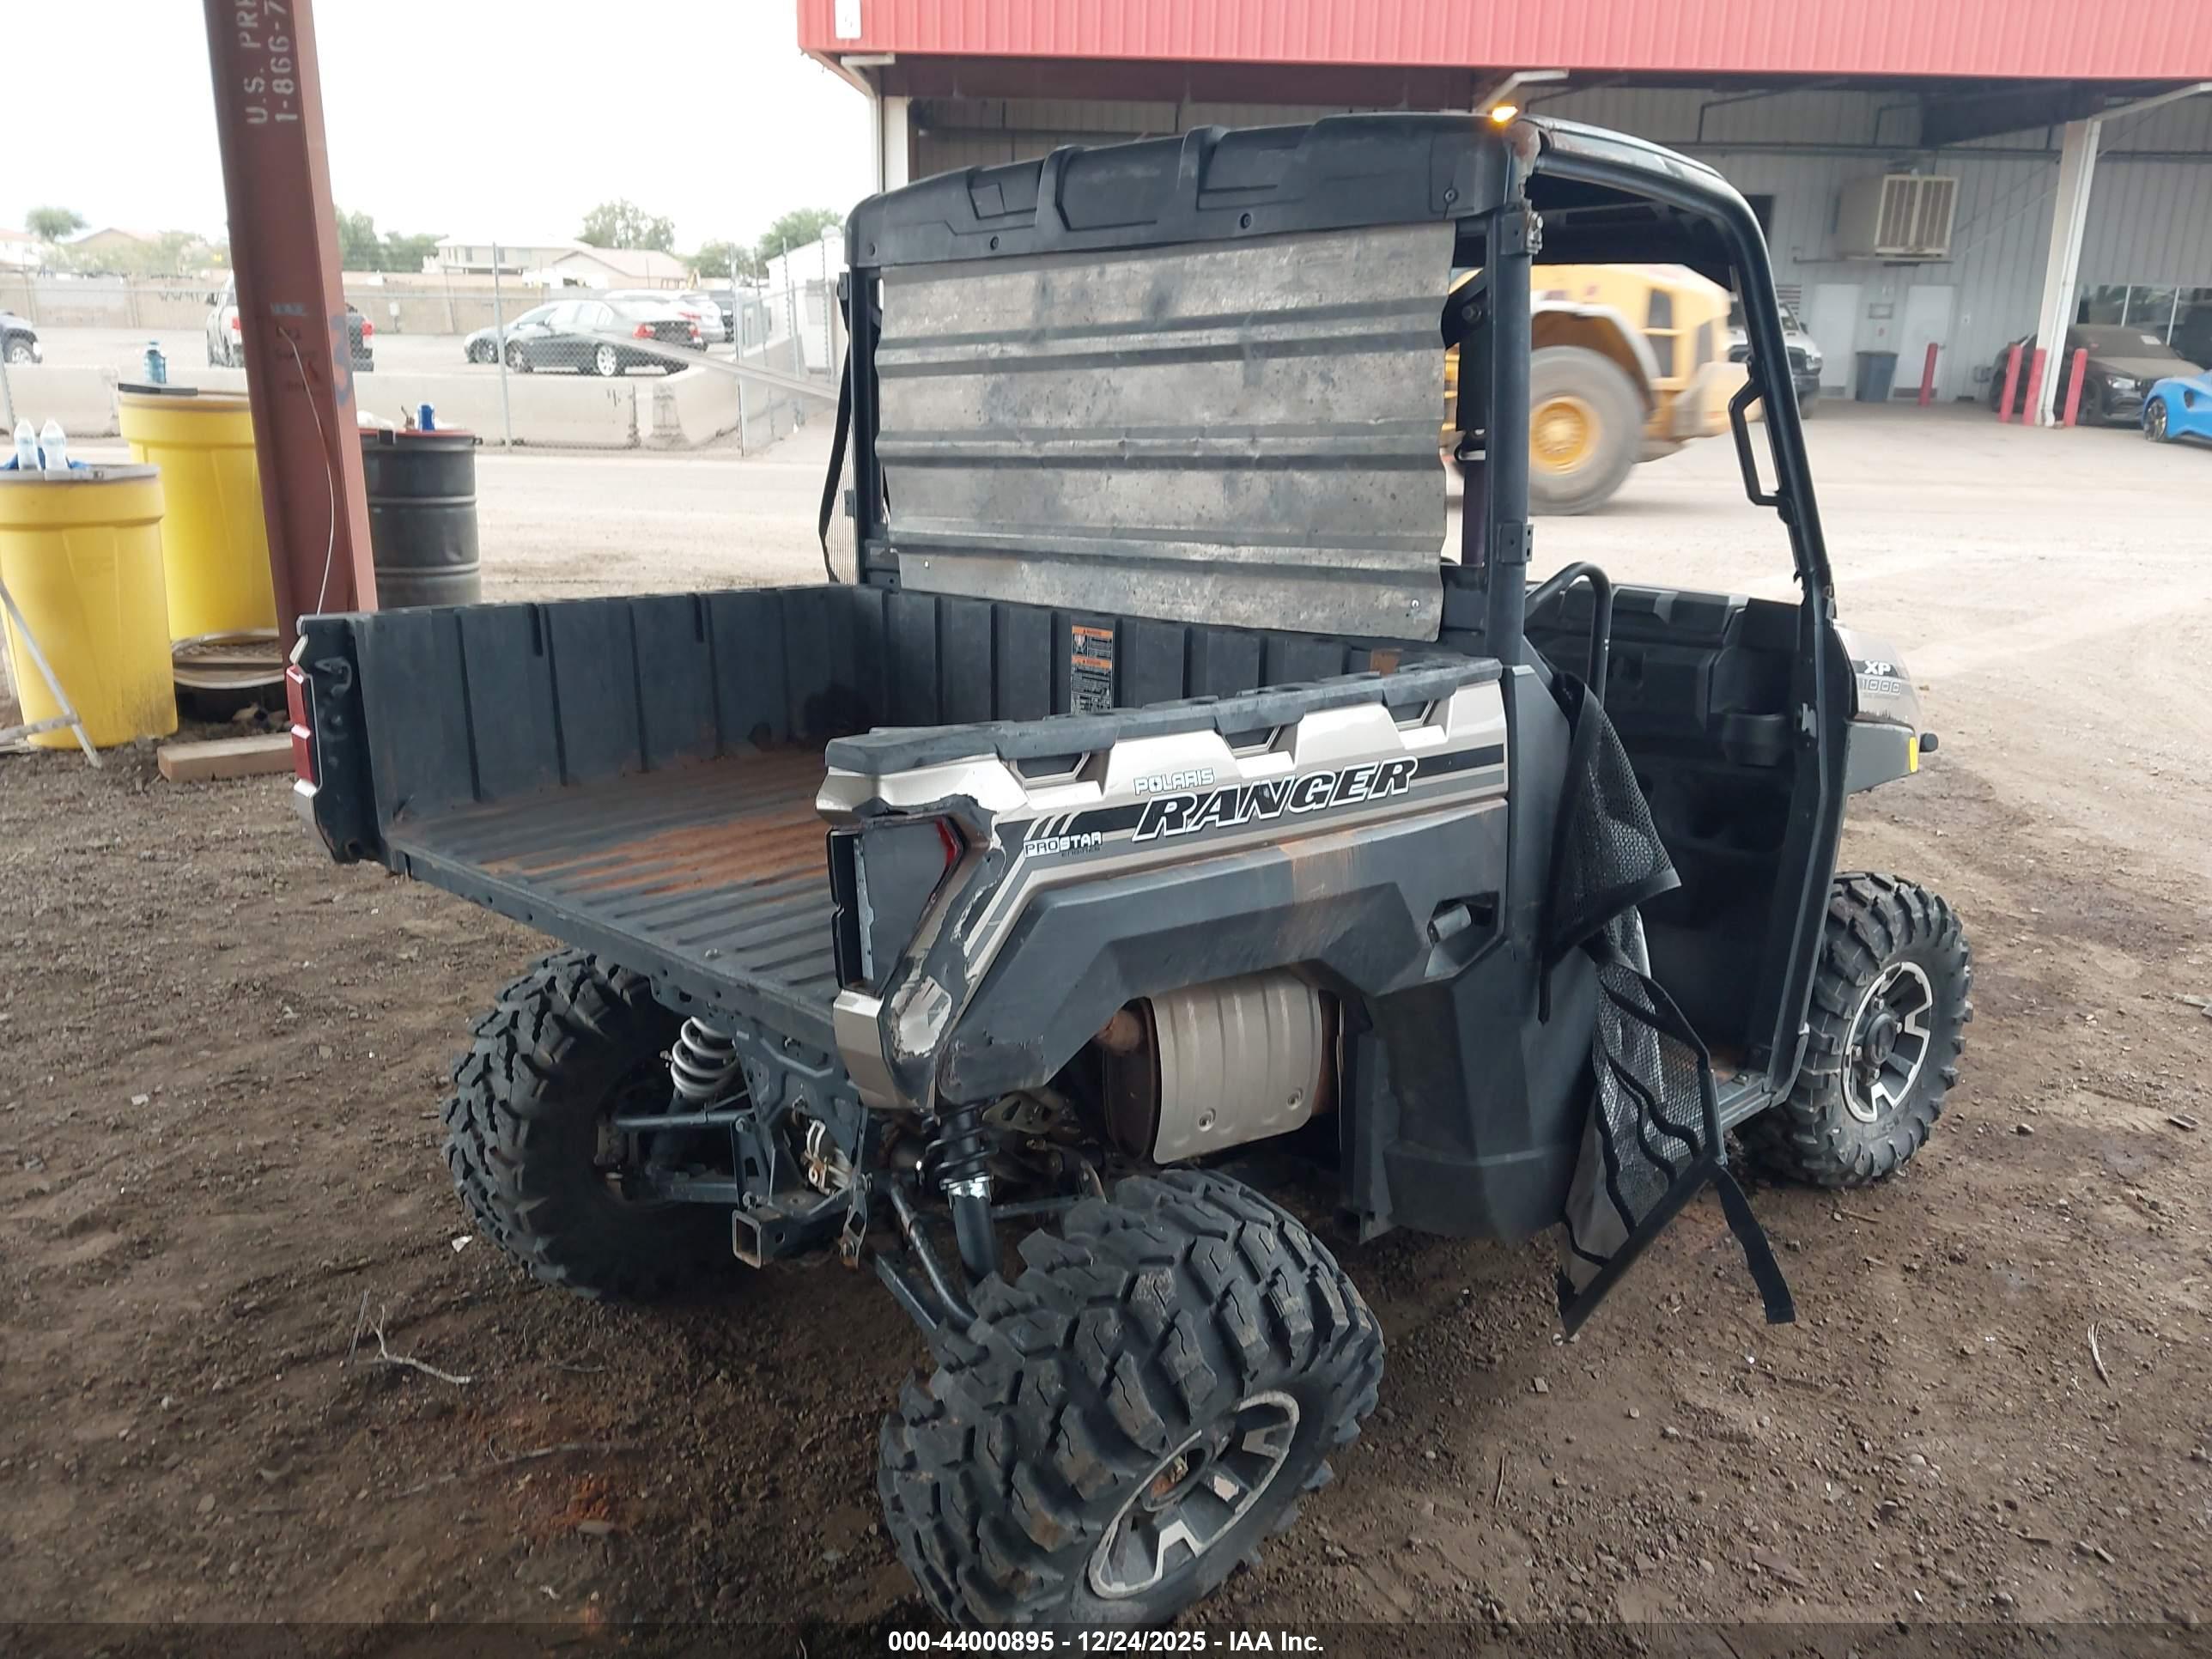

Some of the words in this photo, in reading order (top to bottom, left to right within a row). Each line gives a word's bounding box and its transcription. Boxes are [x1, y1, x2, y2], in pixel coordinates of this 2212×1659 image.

[263, 0, 298, 122] 1-866-7
[243, 68, 269, 125] U.S.
[1863, 659, 1891, 676] XP
[1862, 678, 1901, 696] 1000
[1133, 767, 1215, 795] POLARIS
[1132, 757, 1419, 842] RANGER
[1023, 831, 1103, 858] PROSTAR
